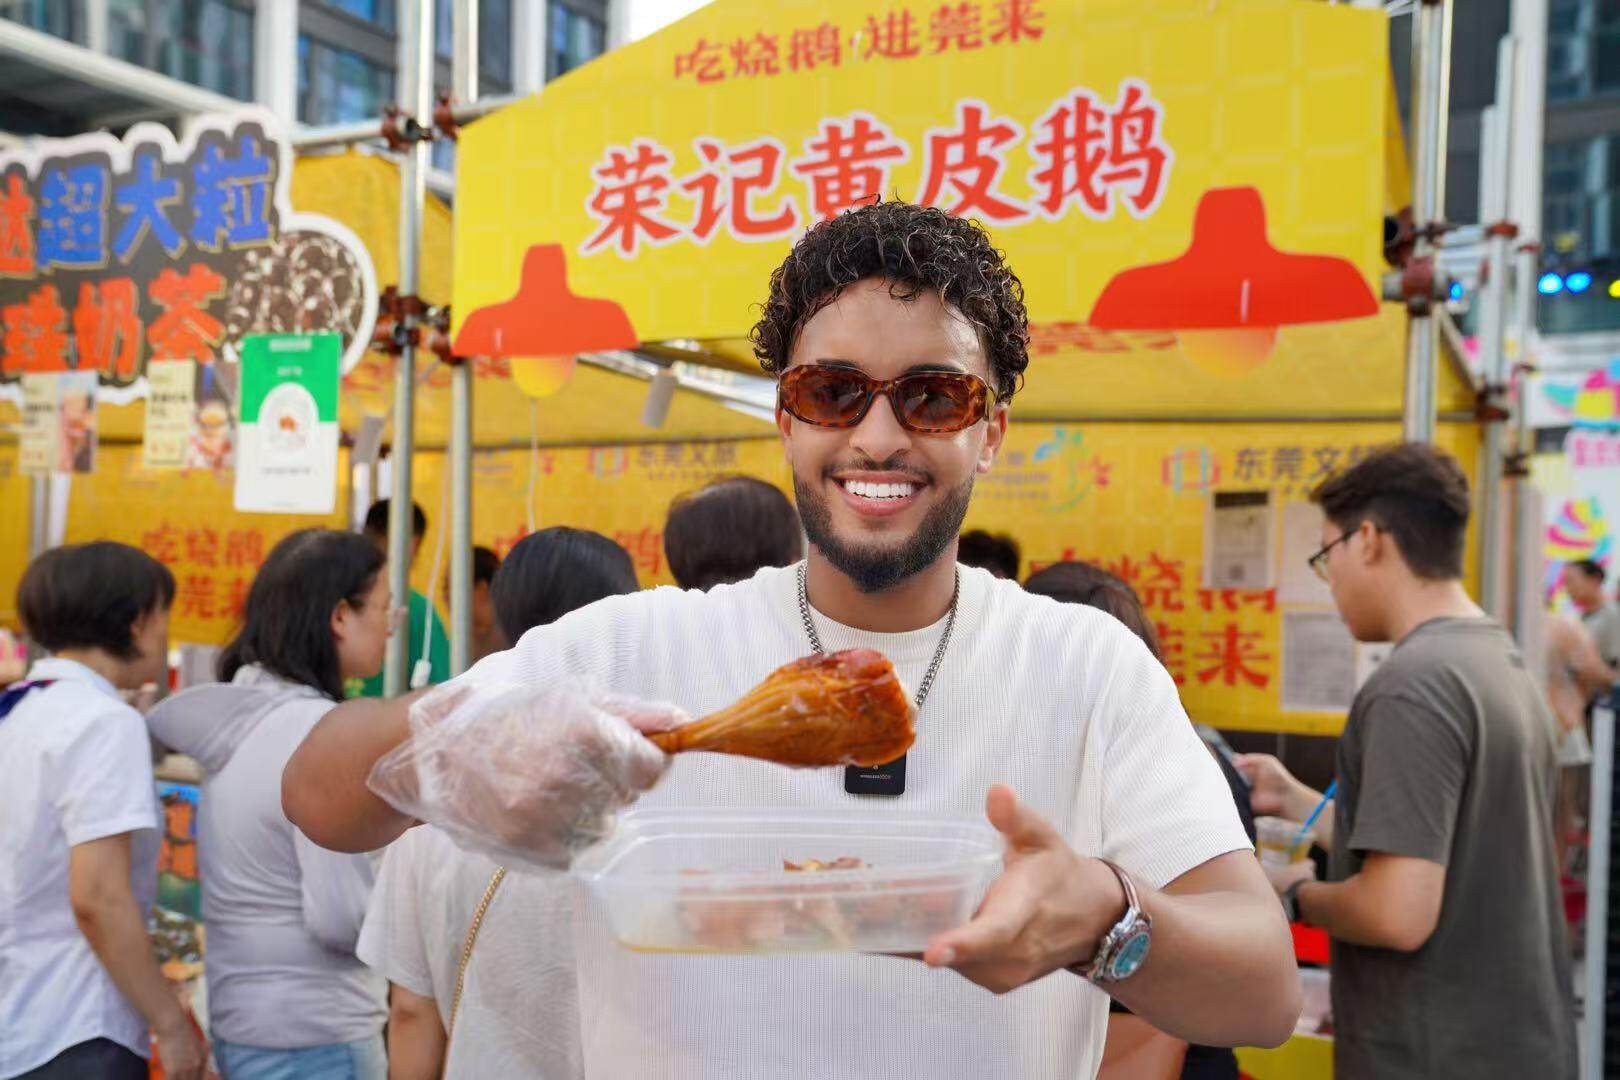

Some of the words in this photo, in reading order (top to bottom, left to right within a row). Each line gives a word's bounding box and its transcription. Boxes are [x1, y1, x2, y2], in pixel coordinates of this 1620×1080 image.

[580, 83, 1169, 255] 荣记黄皮鹅
